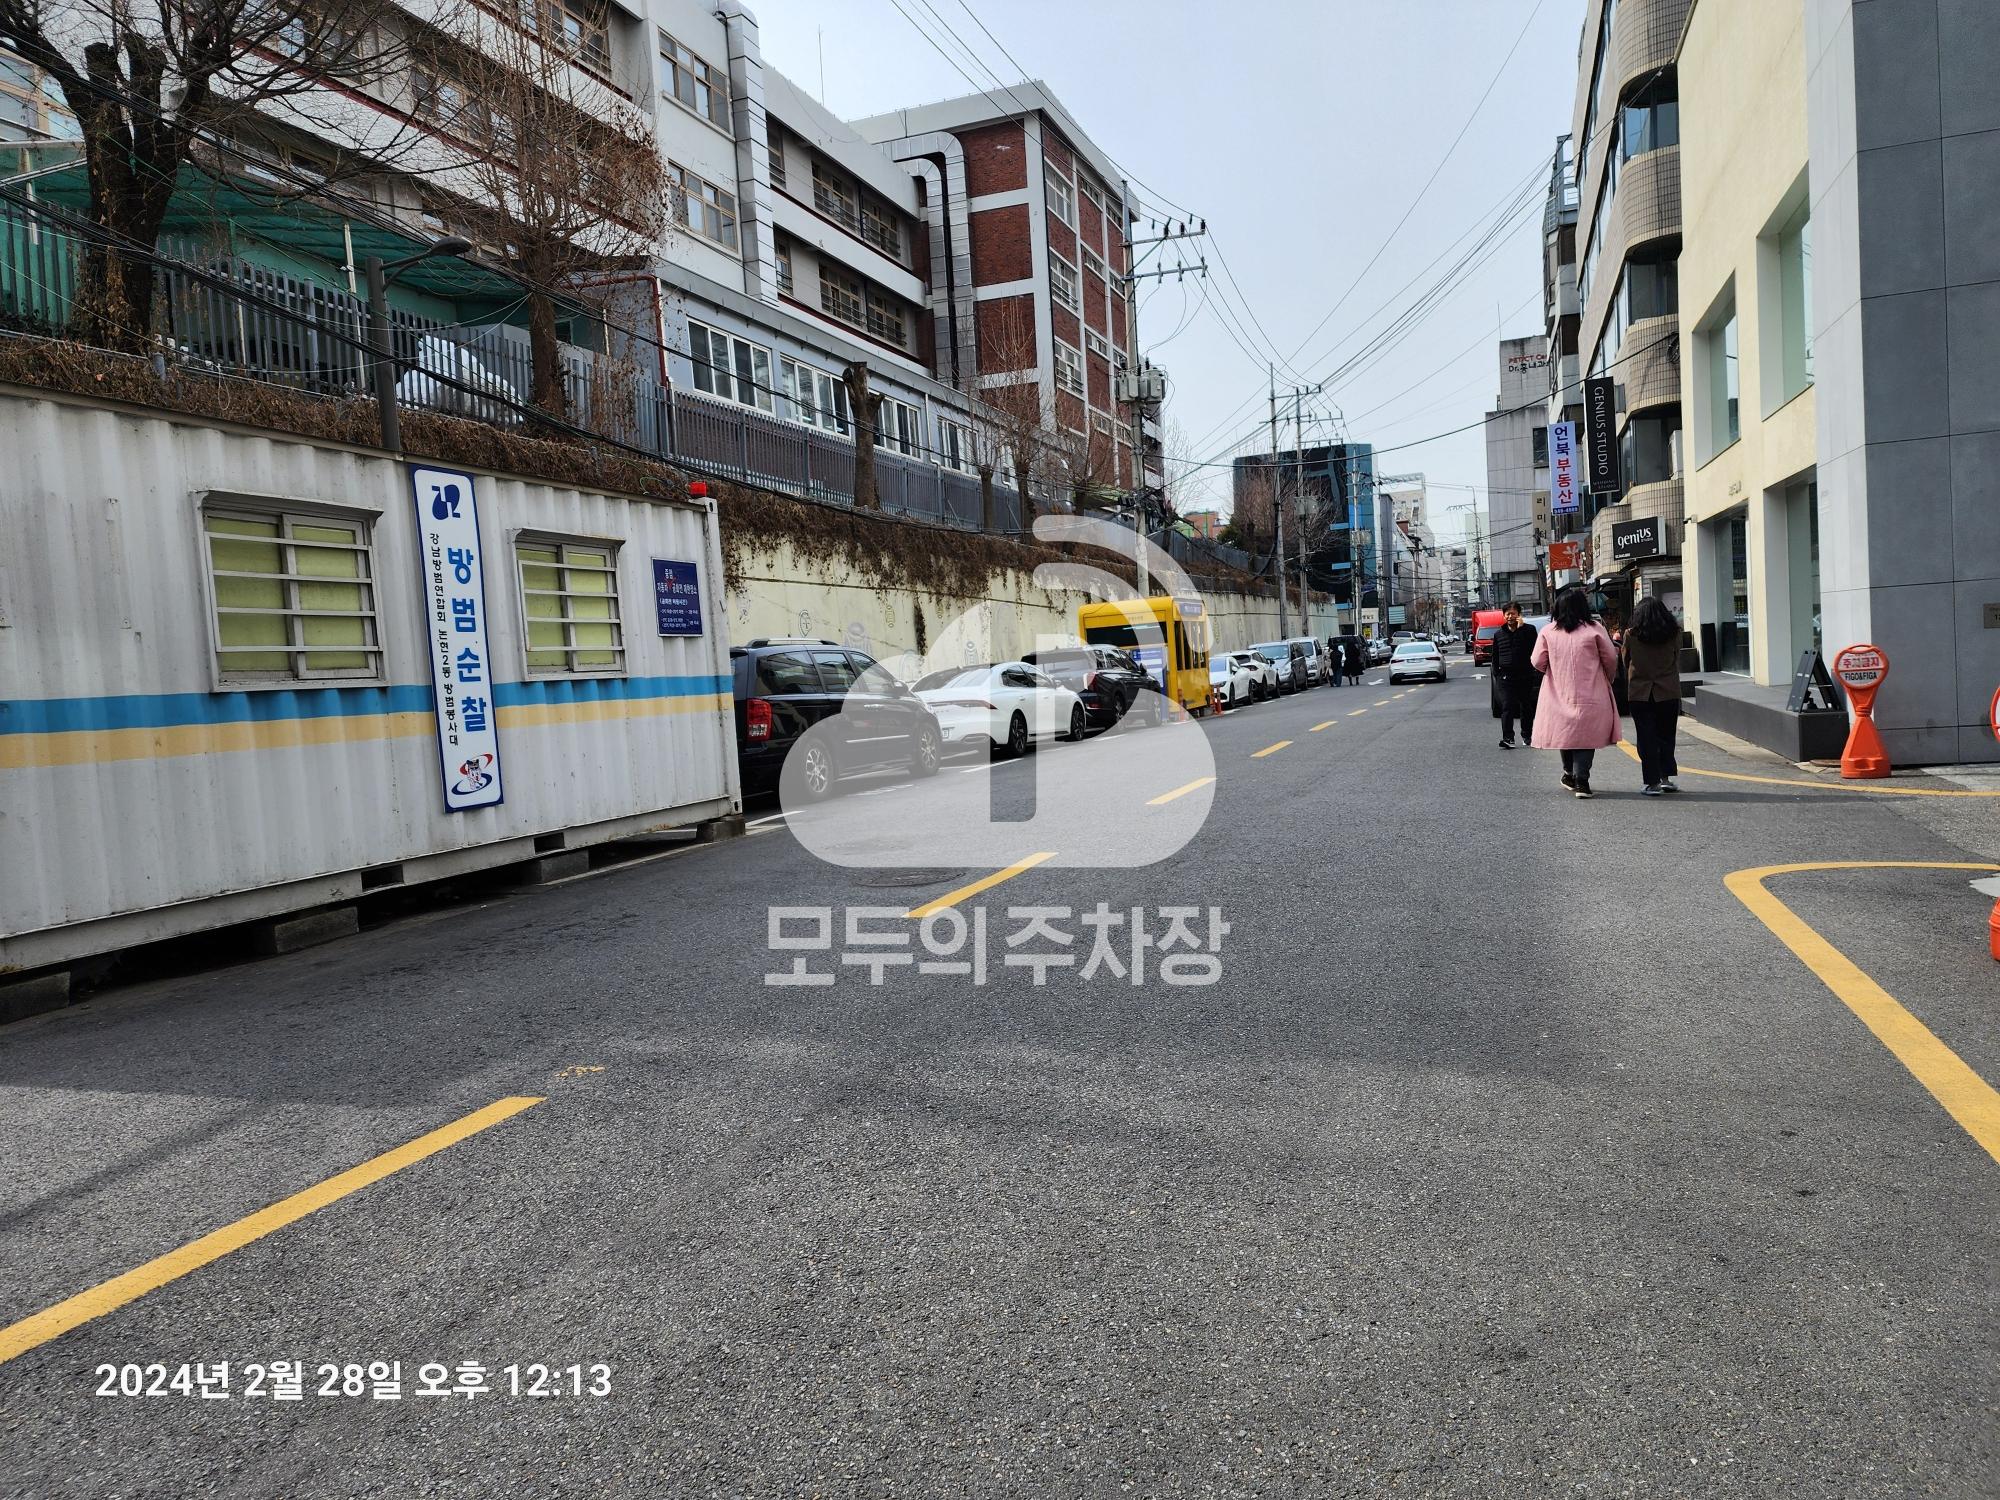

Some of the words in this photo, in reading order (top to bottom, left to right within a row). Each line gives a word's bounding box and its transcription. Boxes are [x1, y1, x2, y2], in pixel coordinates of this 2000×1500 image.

[1594, 386, 1606, 429] GENIUS
[1596, 432, 1609, 475] STUDIO
[1617, 527, 1652, 549] genius
[430, 532, 446, 623] 강남방범연합회
[656, 582, 669, 593] 자동차
[438, 629, 452, 679] 논현2동
[447, 547, 488, 733] 방범순찰
[1844, 671, 1878, 681] FIGO&FIGA
[444, 683, 459, 746] 방범봉사대
